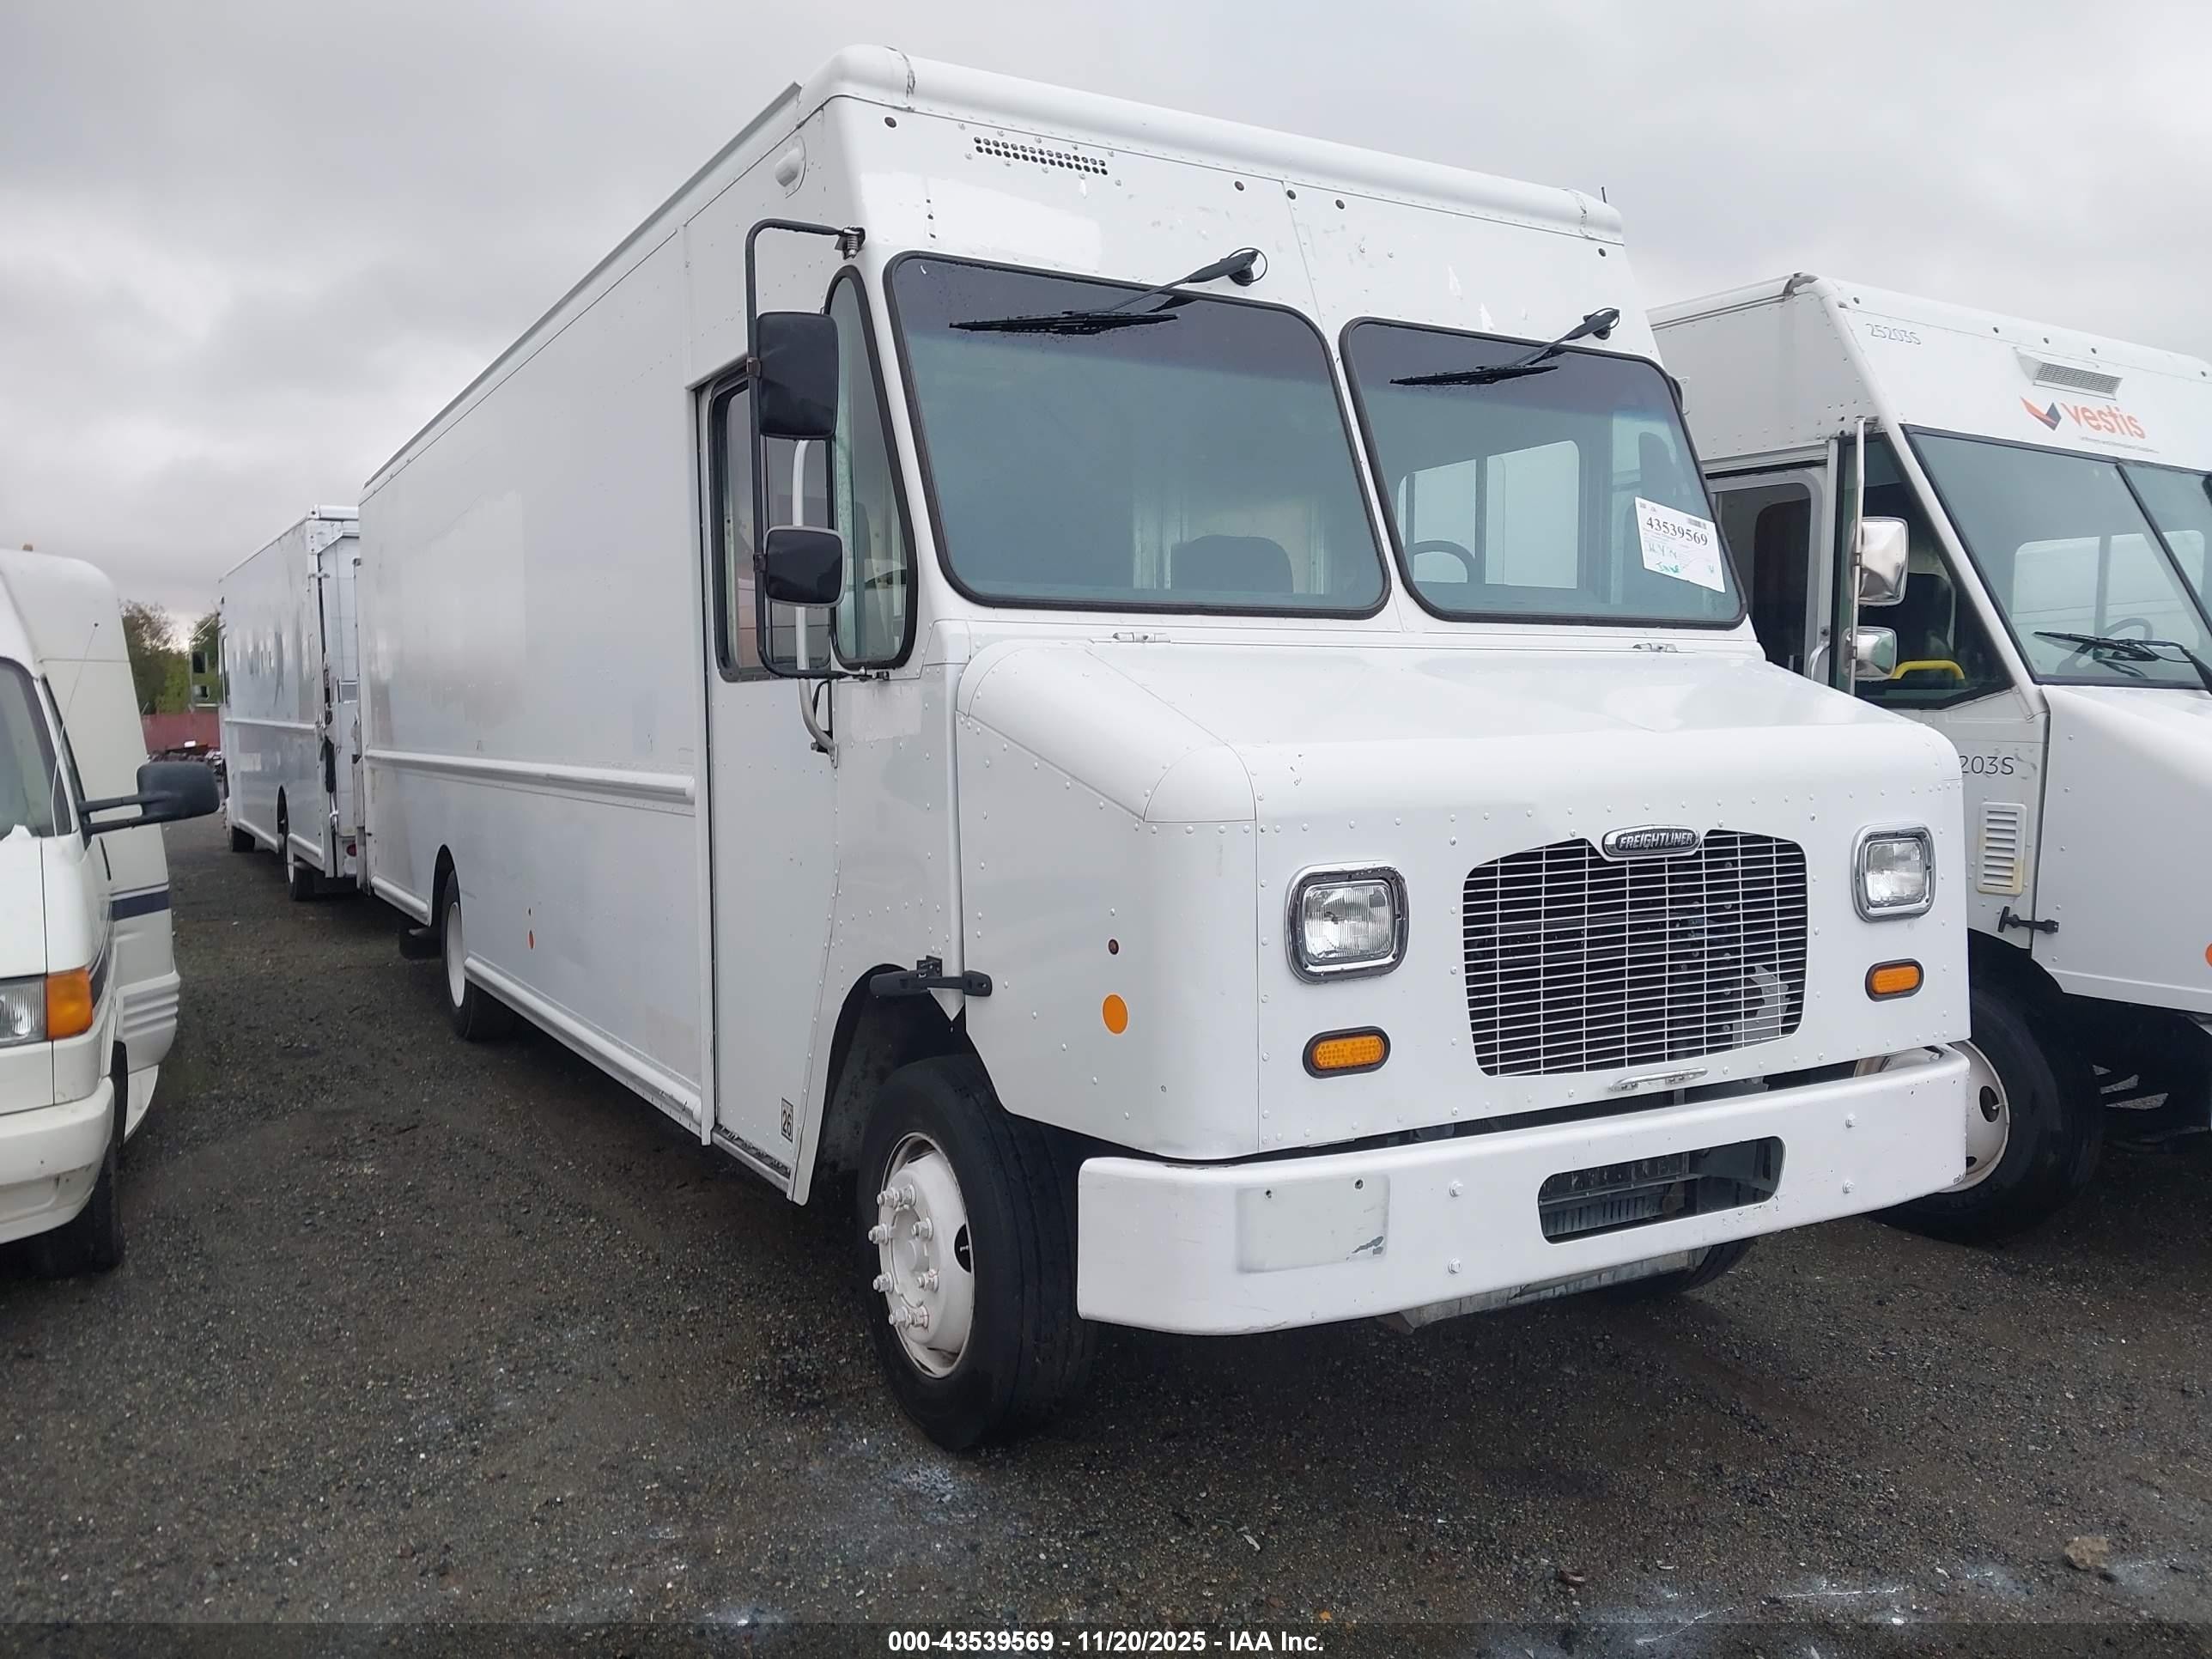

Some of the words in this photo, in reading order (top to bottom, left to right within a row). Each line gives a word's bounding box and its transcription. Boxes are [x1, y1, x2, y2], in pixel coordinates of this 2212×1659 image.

[2060, 403, 2146, 439] vestis
[1646, 516, 1708, 546] 43539569
[1619, 831, 1693, 850] FREIGHTLINER
[782, 1109, 792, 1138] 26
